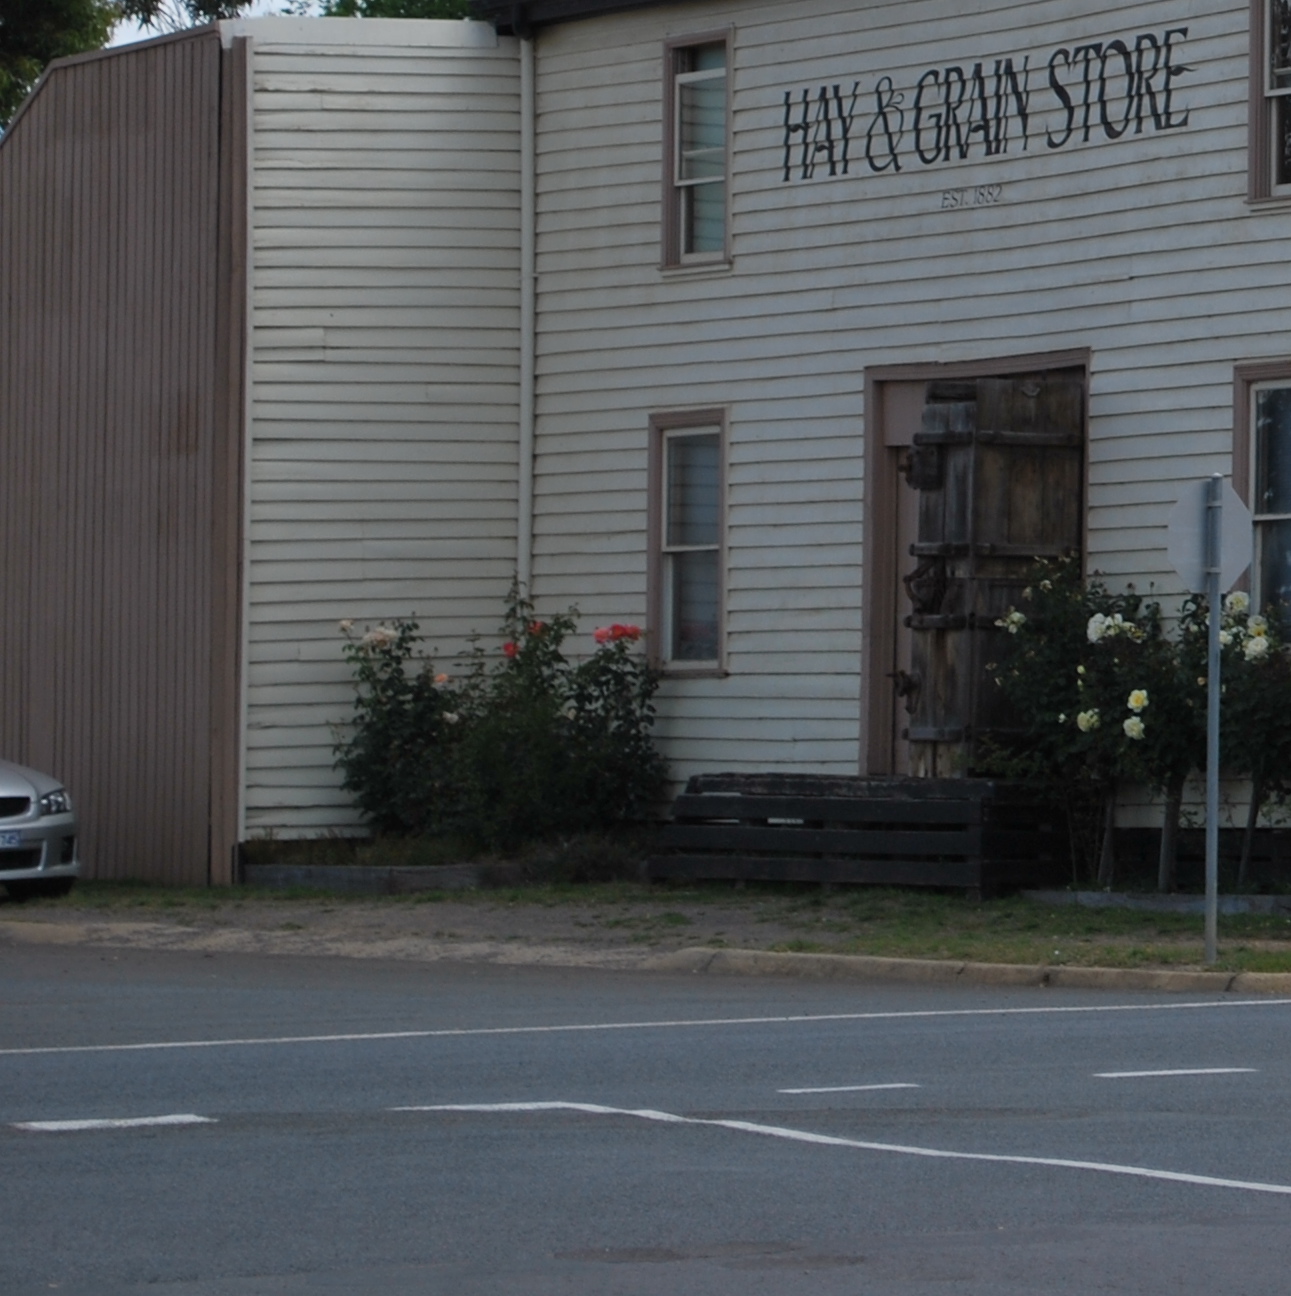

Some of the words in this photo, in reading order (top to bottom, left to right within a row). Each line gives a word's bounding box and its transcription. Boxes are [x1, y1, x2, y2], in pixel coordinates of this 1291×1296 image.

[782, 80, 860, 182] HAY
[864, 75, 906, 174] &
[913, 54, 1030, 165] GRAIN
[1045, 26, 1198, 150] STORE
[940, 188, 968, 209] EST.
[973, 183, 1003, 206] 1882
